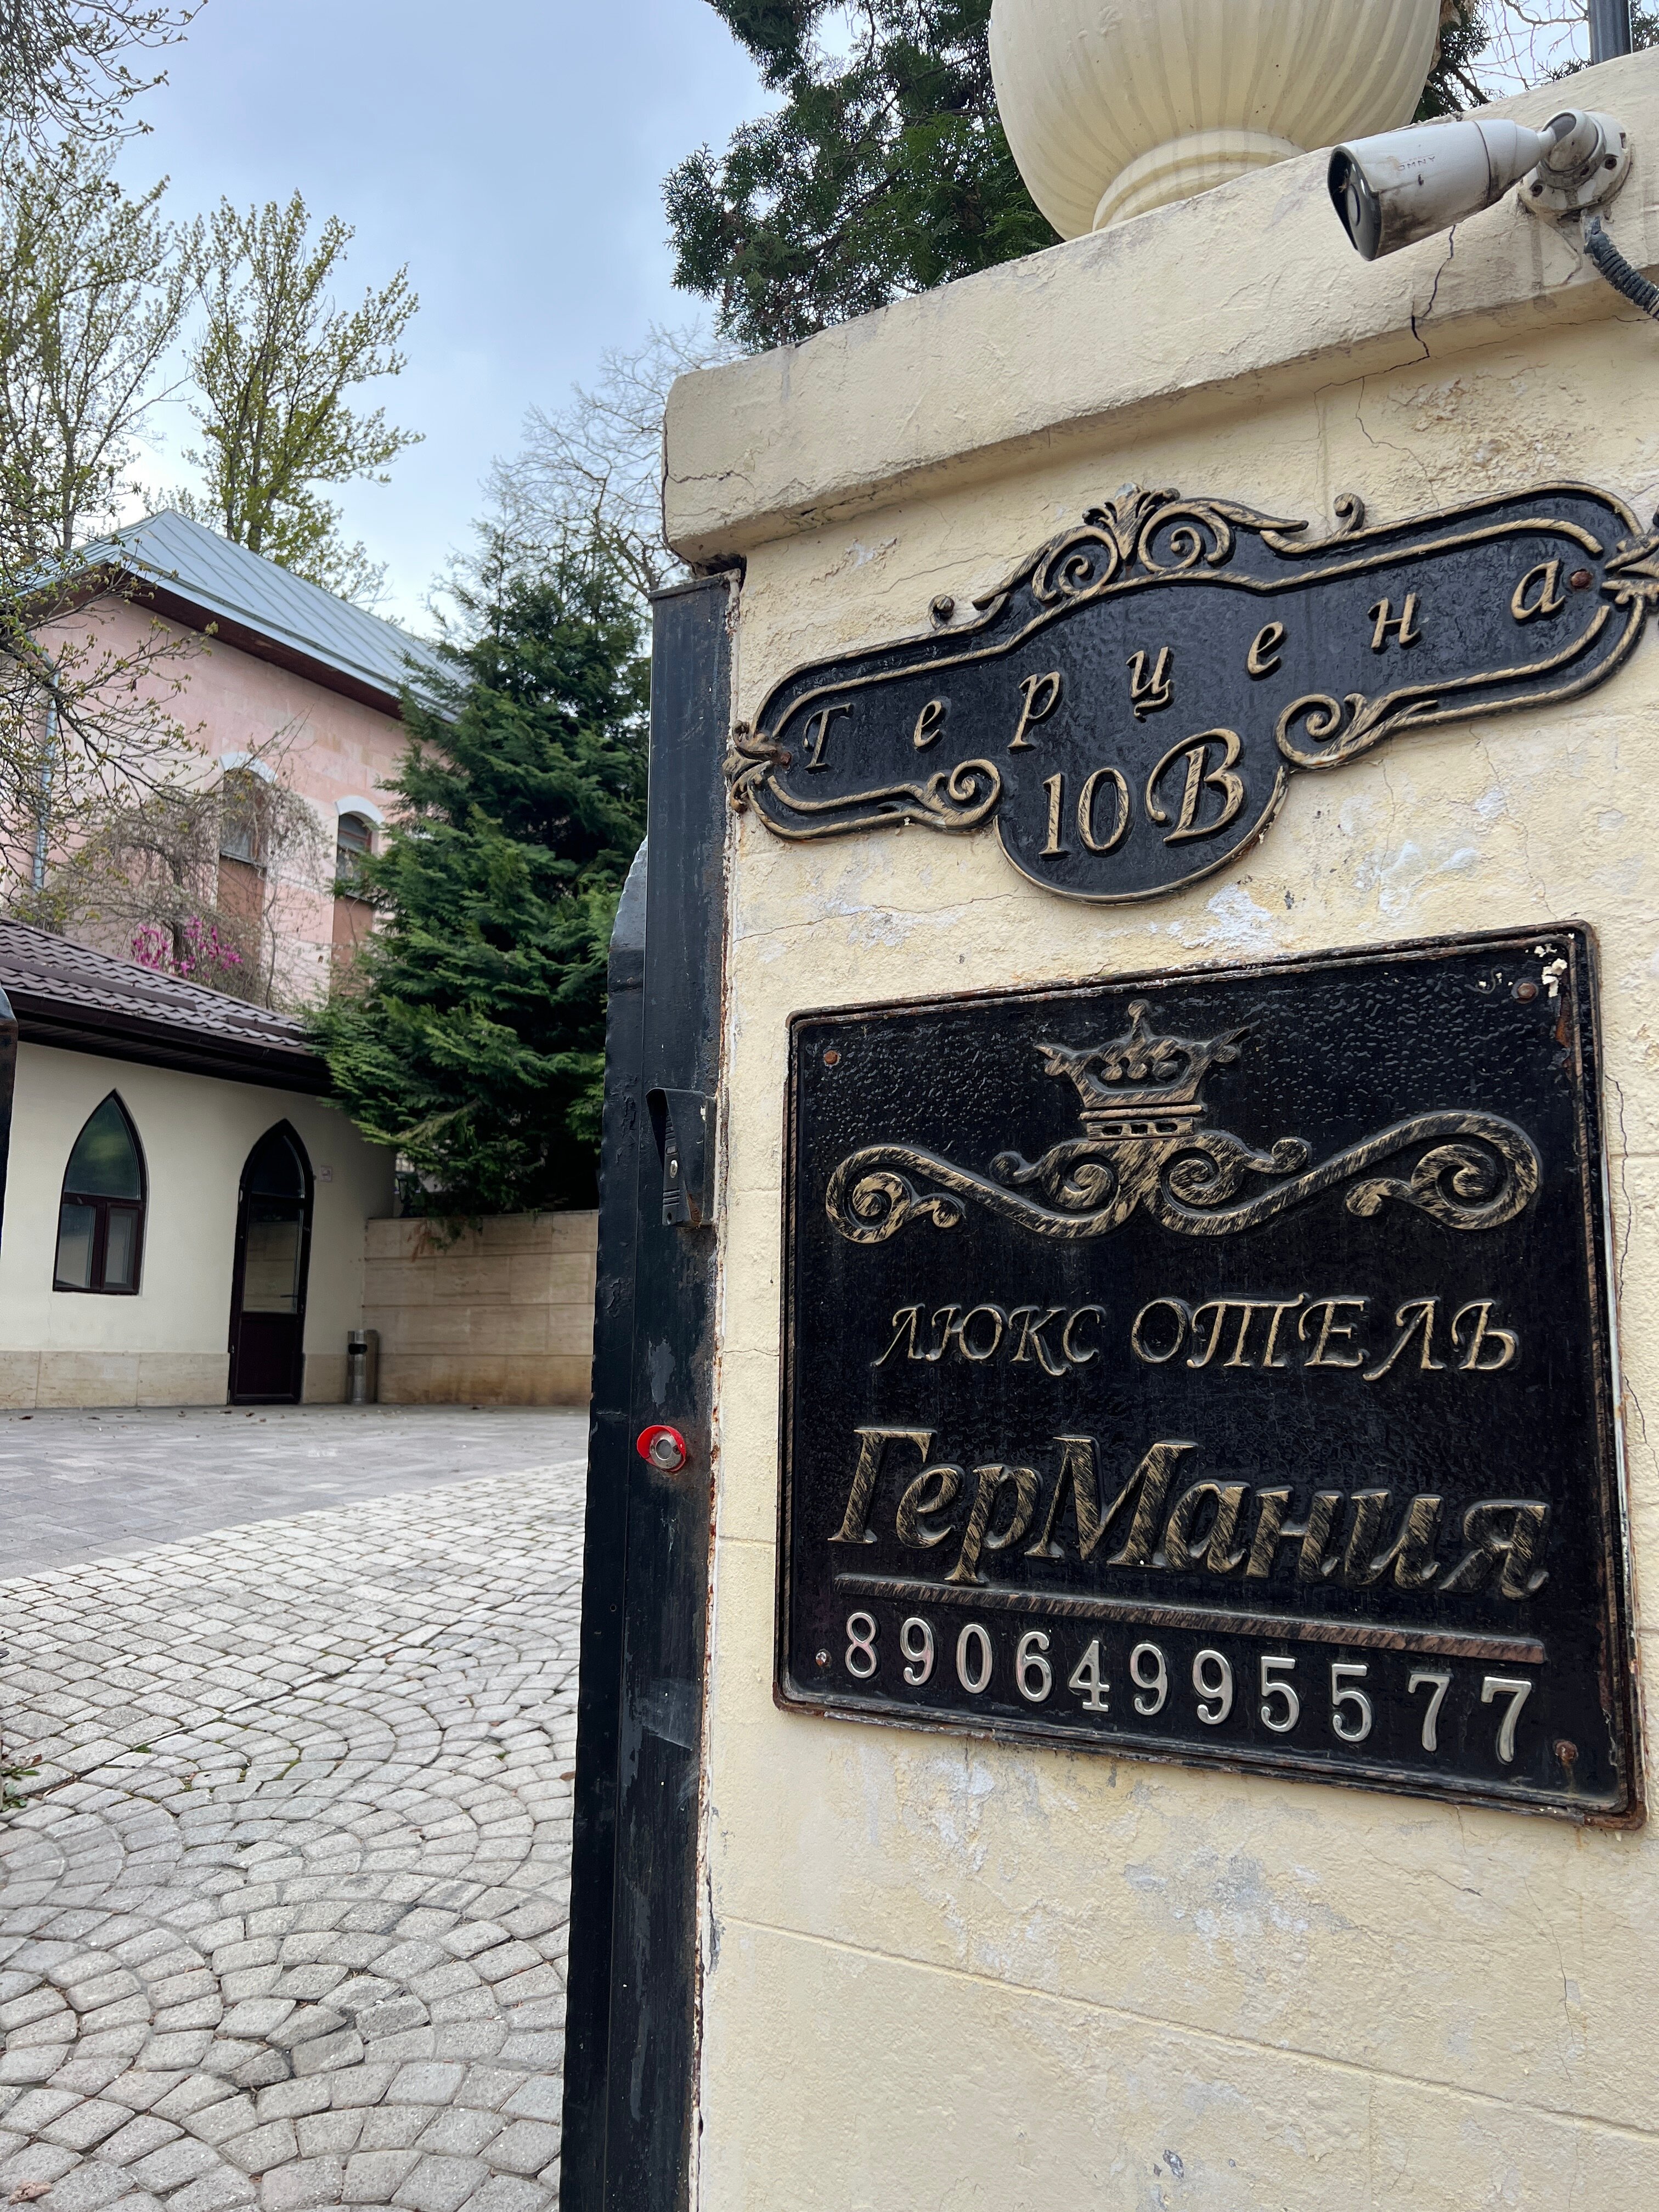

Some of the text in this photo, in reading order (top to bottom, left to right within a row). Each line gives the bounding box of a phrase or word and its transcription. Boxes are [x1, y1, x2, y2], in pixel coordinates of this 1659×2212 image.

[803, 558, 1565, 771] Герцена
[870, 1293, 1520, 1381] ЛЮКС ОТЕЛЬ
[845, 1612, 1533, 1763] 89064995577
